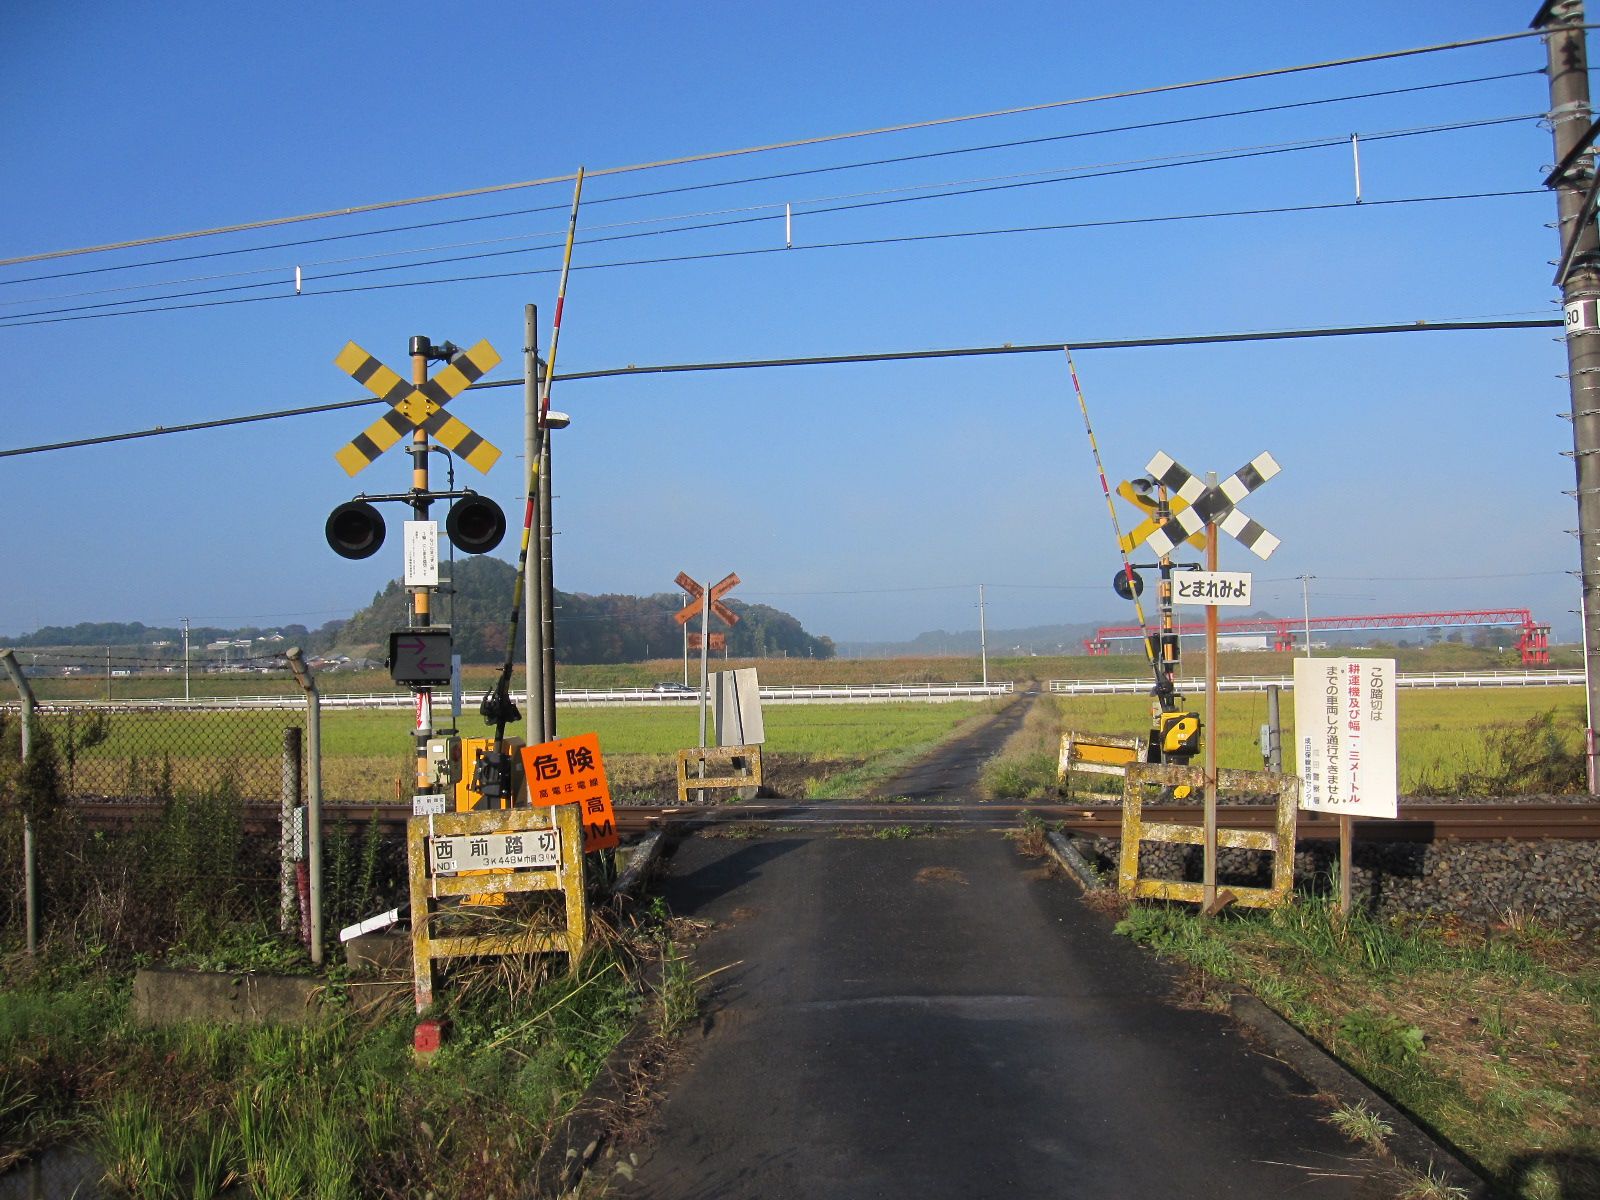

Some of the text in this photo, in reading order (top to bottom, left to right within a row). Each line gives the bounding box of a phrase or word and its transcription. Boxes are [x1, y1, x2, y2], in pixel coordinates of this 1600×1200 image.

[1566, 309, 1579, 326] 30
[1178, 579, 1247, 598] とまれみよ
[1370, 666, 1383, 722] この踏切は
[1326, 665, 1339, 805] までの車両しか通行できません
[533, 746, 595, 781] 危険
[434, 832, 557, 860] 西前踏切
